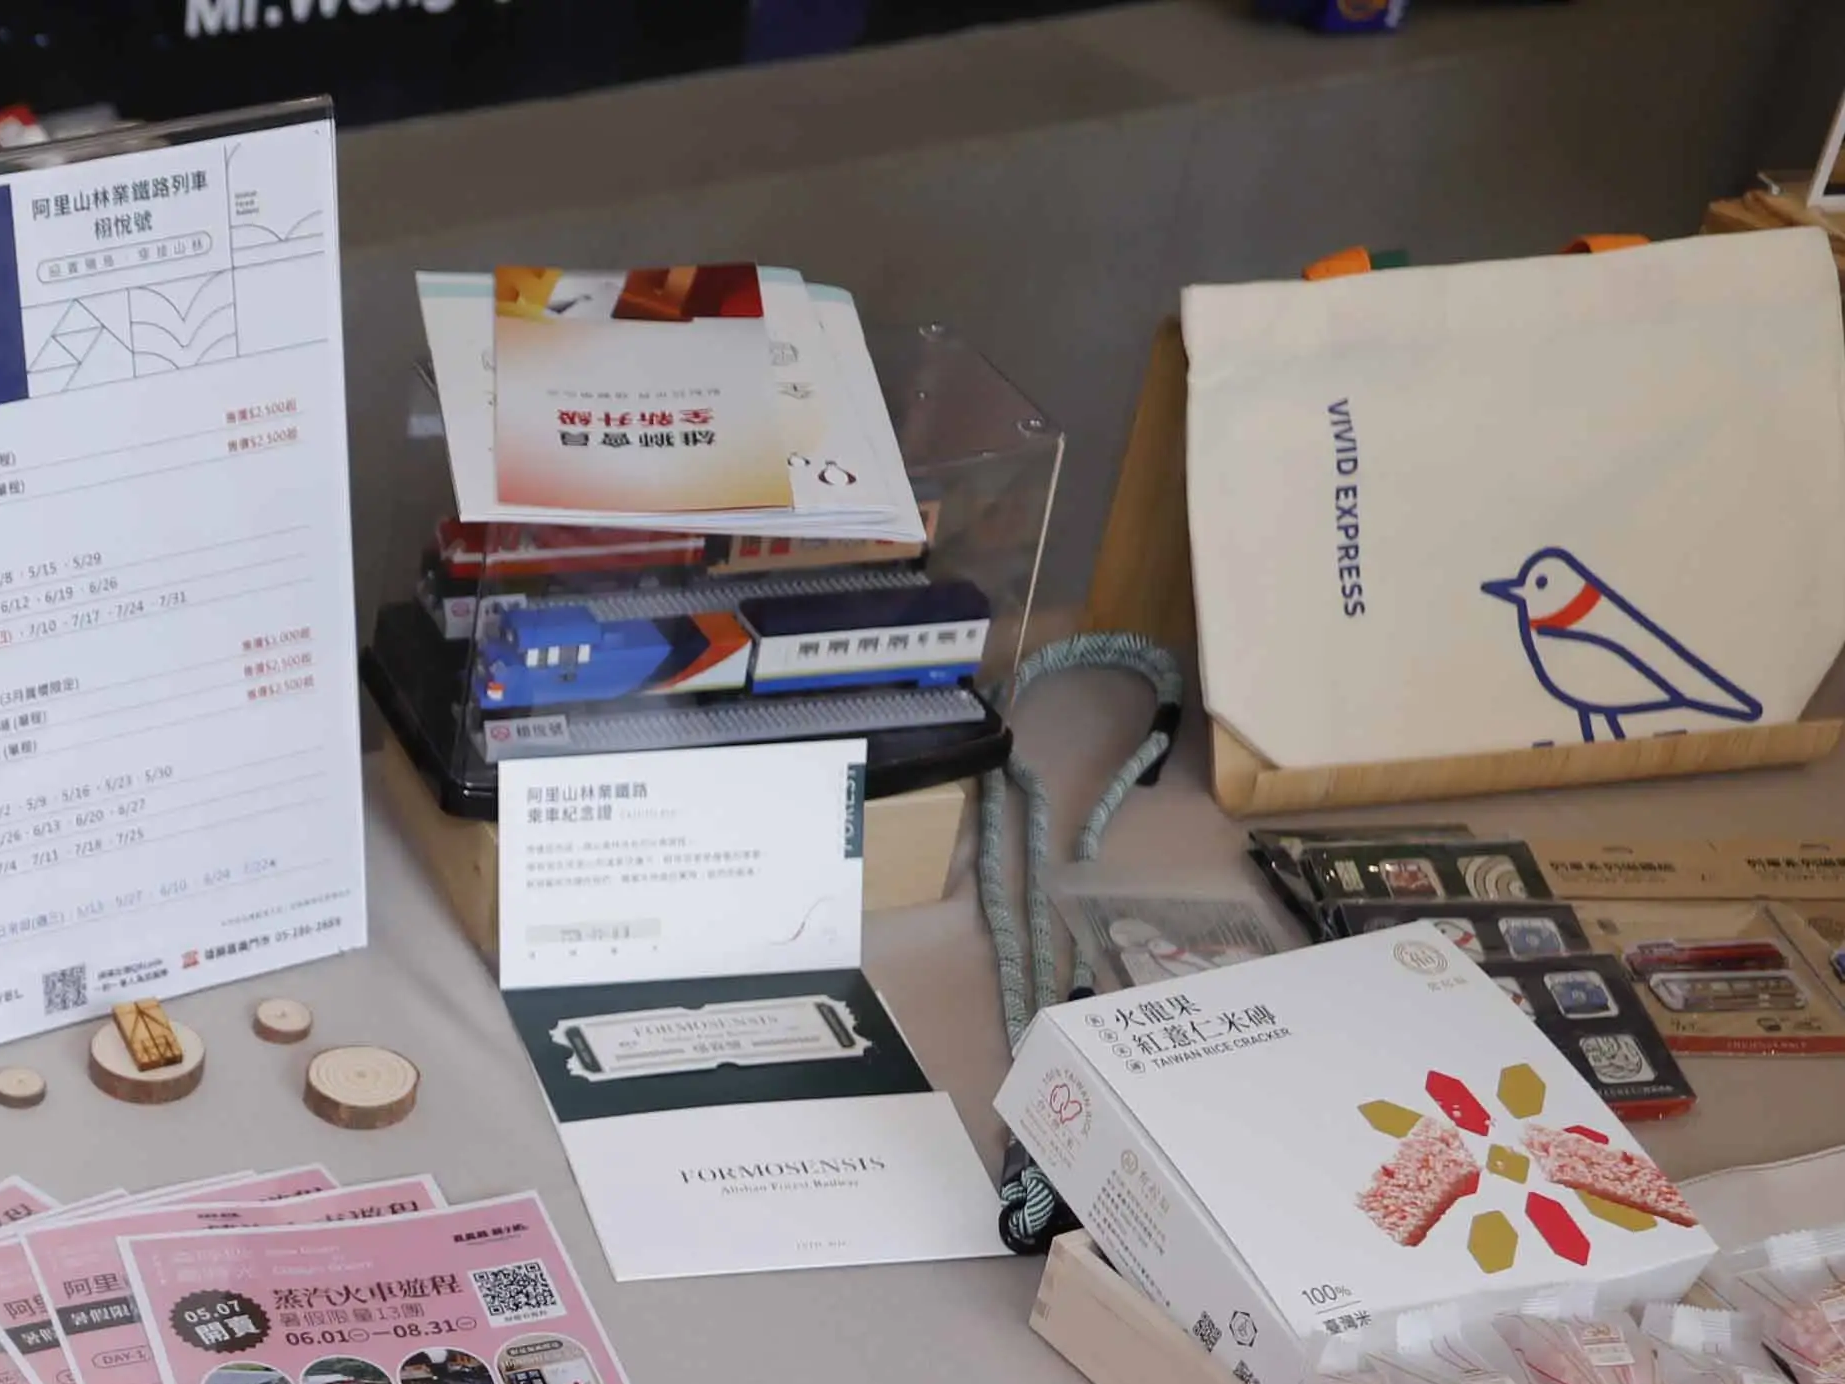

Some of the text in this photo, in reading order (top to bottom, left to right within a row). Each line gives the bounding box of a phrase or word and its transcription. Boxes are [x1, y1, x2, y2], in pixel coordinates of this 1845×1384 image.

[31, 169, 208, 222] 阿里山林業鐵路列車
[93, 209, 153, 242] 栩悅號
[1327, 397, 1366, 618] VIVID EXPRESS
[1115, 993, 1203, 1031] 火龍果
[1151, 1049, 1203, 1072] TAIWAN
[1234, 1026, 1292, 1051] CRACKER
[679, 1155, 887, 1185] FORMOSENSIS
[271, 1272, 464, 1310] 蒸汽火車遊程
[1301, 1282, 1354, 1307] 100%
[183, 1299, 243, 1324] 05.07
